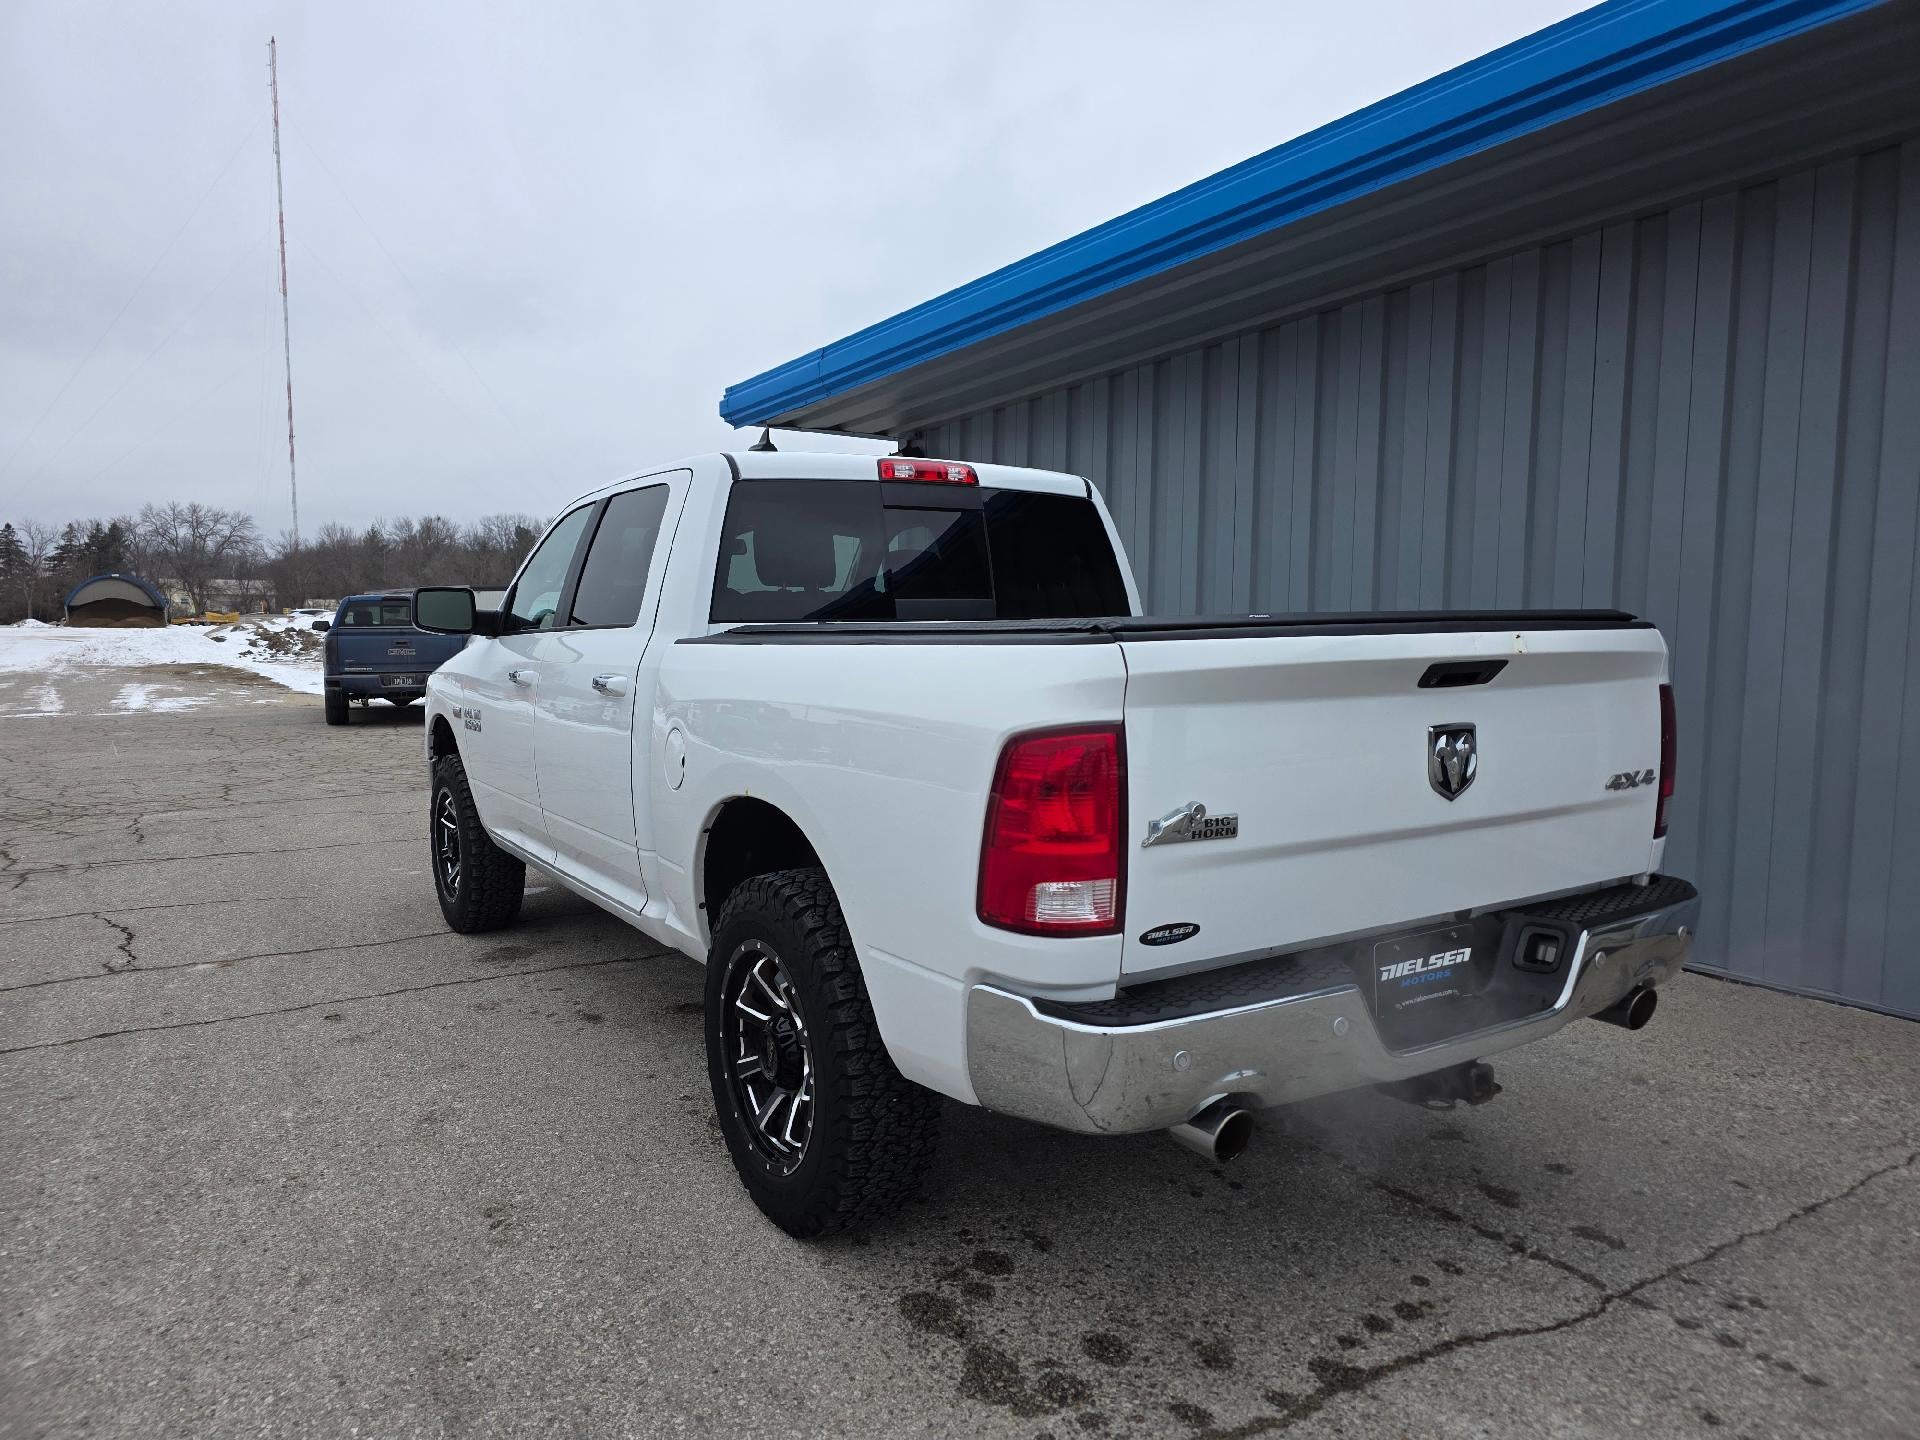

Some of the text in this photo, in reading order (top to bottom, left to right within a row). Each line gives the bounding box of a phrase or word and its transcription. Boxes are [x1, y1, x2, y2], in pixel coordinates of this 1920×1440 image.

[1204, 816, 1231, 828] BIG
[1191, 827, 1237, 839] HORN
[1146, 925, 1194, 940] NIELSEN
[1380, 947, 1472, 982] NIELSEN
[1401, 969, 1452, 988] MOTORS
